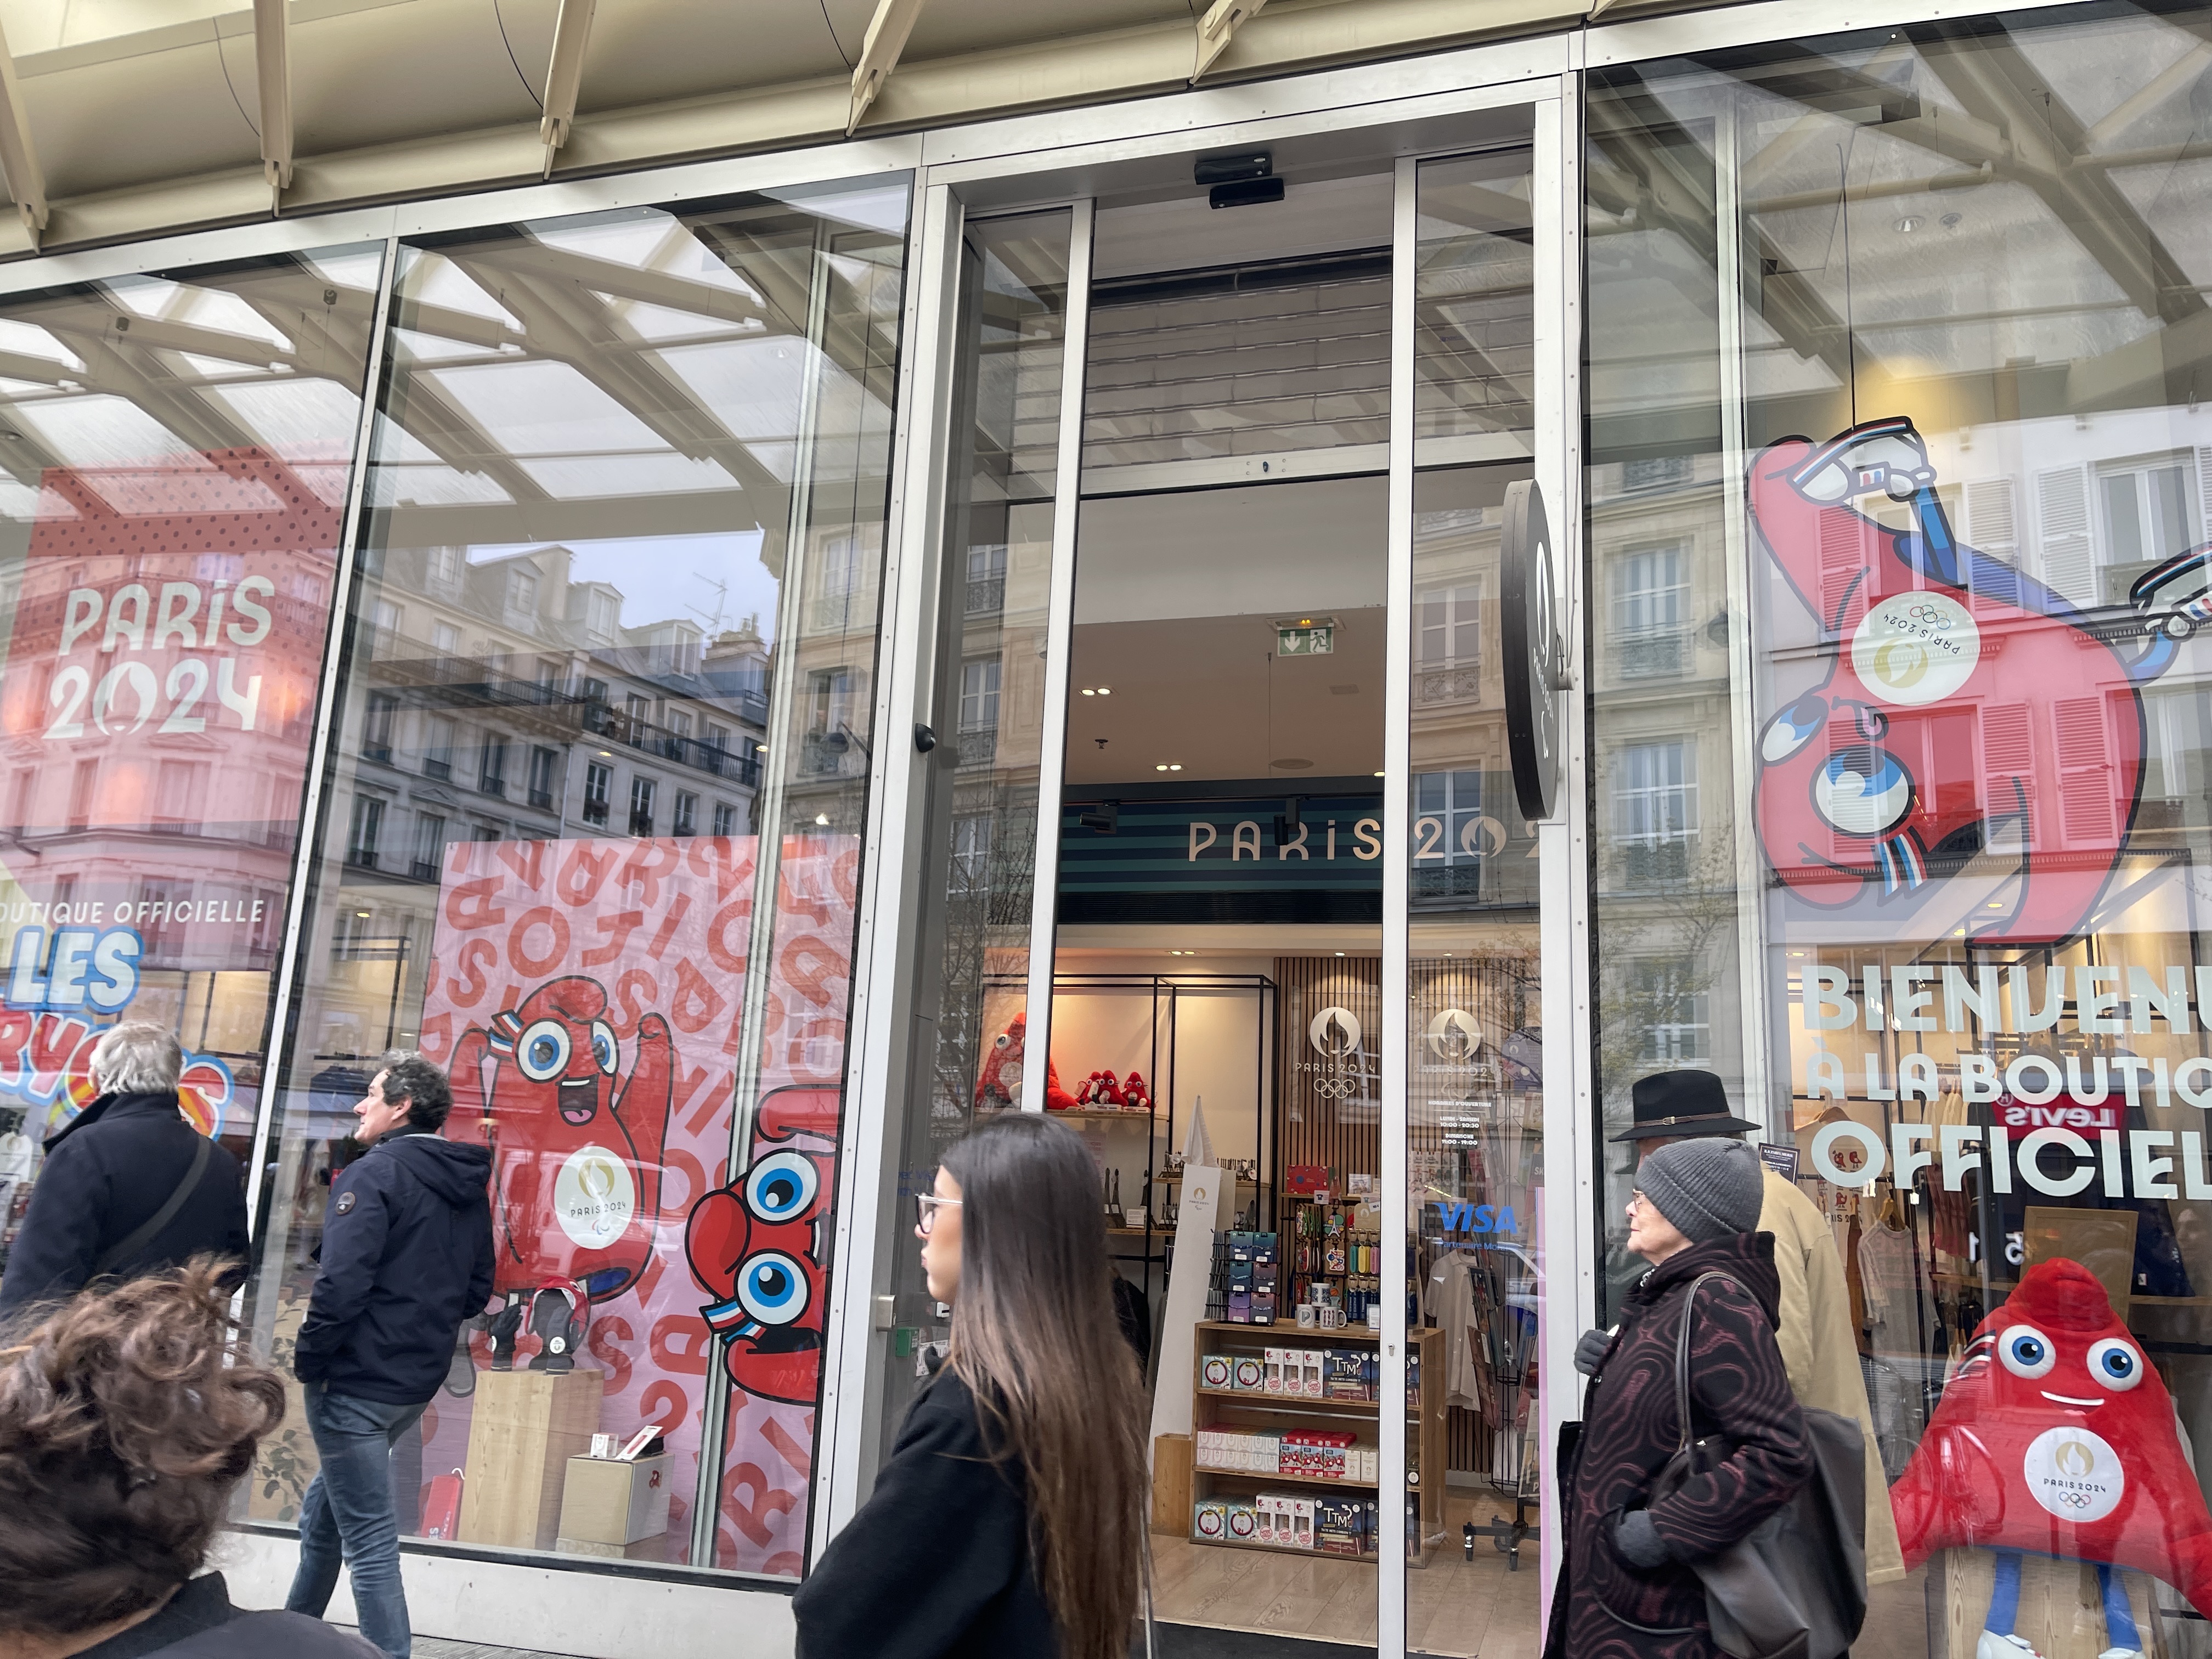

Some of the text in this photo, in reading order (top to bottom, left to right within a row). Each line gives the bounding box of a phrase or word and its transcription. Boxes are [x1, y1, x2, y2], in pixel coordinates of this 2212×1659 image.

[1884, 614, 1917, 633] 2024
[41, 658, 262, 739] 2024
[114, 900, 264, 924] OFFICIELLE
[7, 927, 143, 1012] LES
[1295, 1063, 1375, 1074] PARIS 2024
[1806, 1037, 1845, 1099] À
[1866, 1053, 1940, 1102] LA
[571, 1201, 625, 1217] PARIS 2024
[1432, 1202, 1518, 1234] VISA
[2044, 1478, 2106, 1493] PARIS 2024
